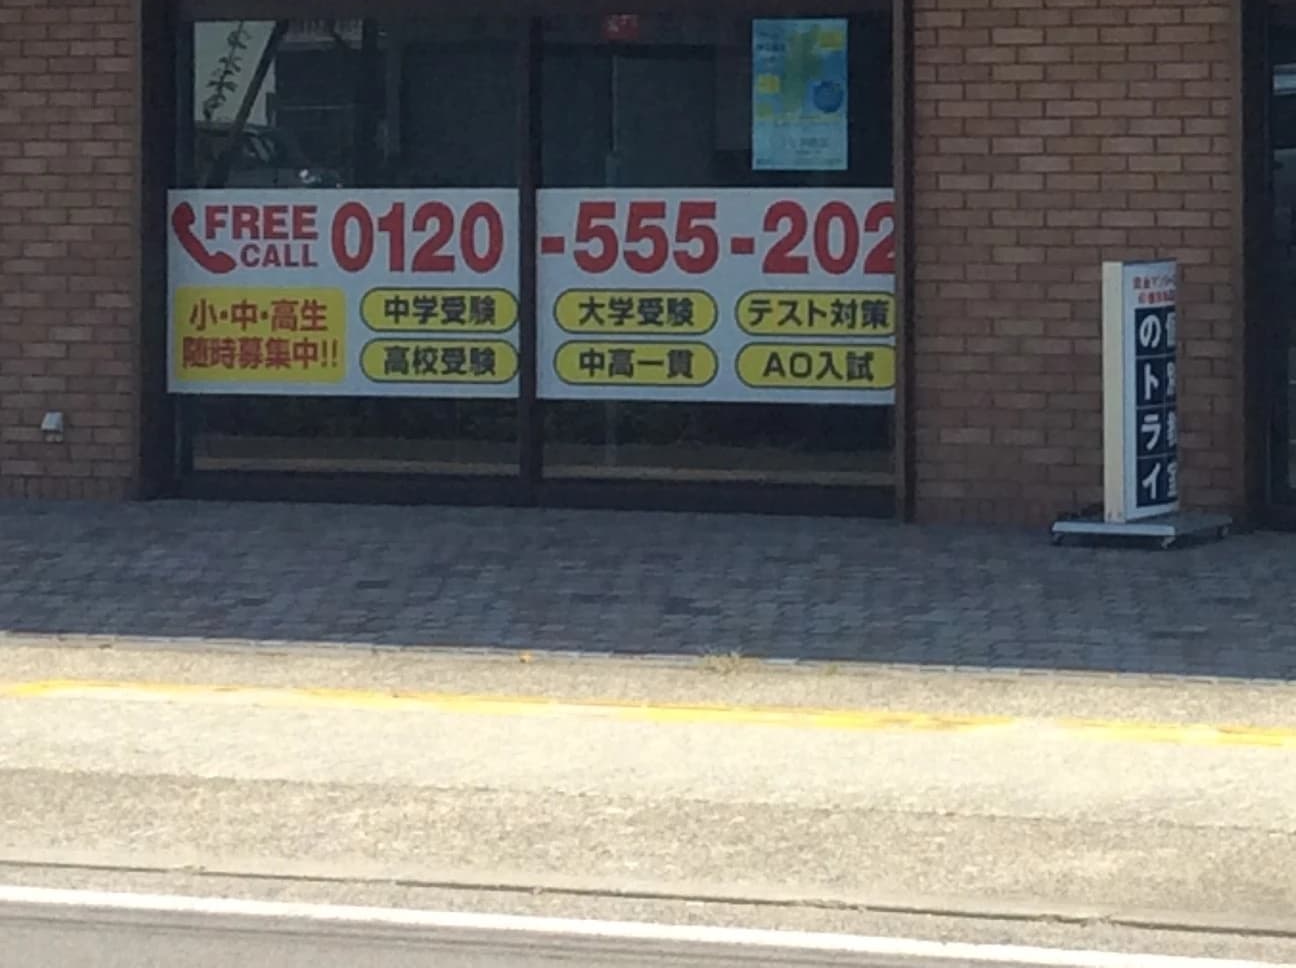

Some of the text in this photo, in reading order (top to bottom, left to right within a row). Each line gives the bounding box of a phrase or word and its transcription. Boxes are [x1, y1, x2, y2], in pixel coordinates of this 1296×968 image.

[205, 205, 319, 240] FREE
[331, 200, 504, 273] 0120
[240, 243, 319, 268] CALL
[384, 295, 496, 325] 中学受験
[579, 297, 695, 327] 大学受験
[748, 299, 890, 329] テスト対策
[384, 346, 496, 376] 高校受験
[579, 348, 694, 380] 中高一貫
[763, 351, 875, 382] AO入試
[1139, 313, 1162, 500] のトライ
